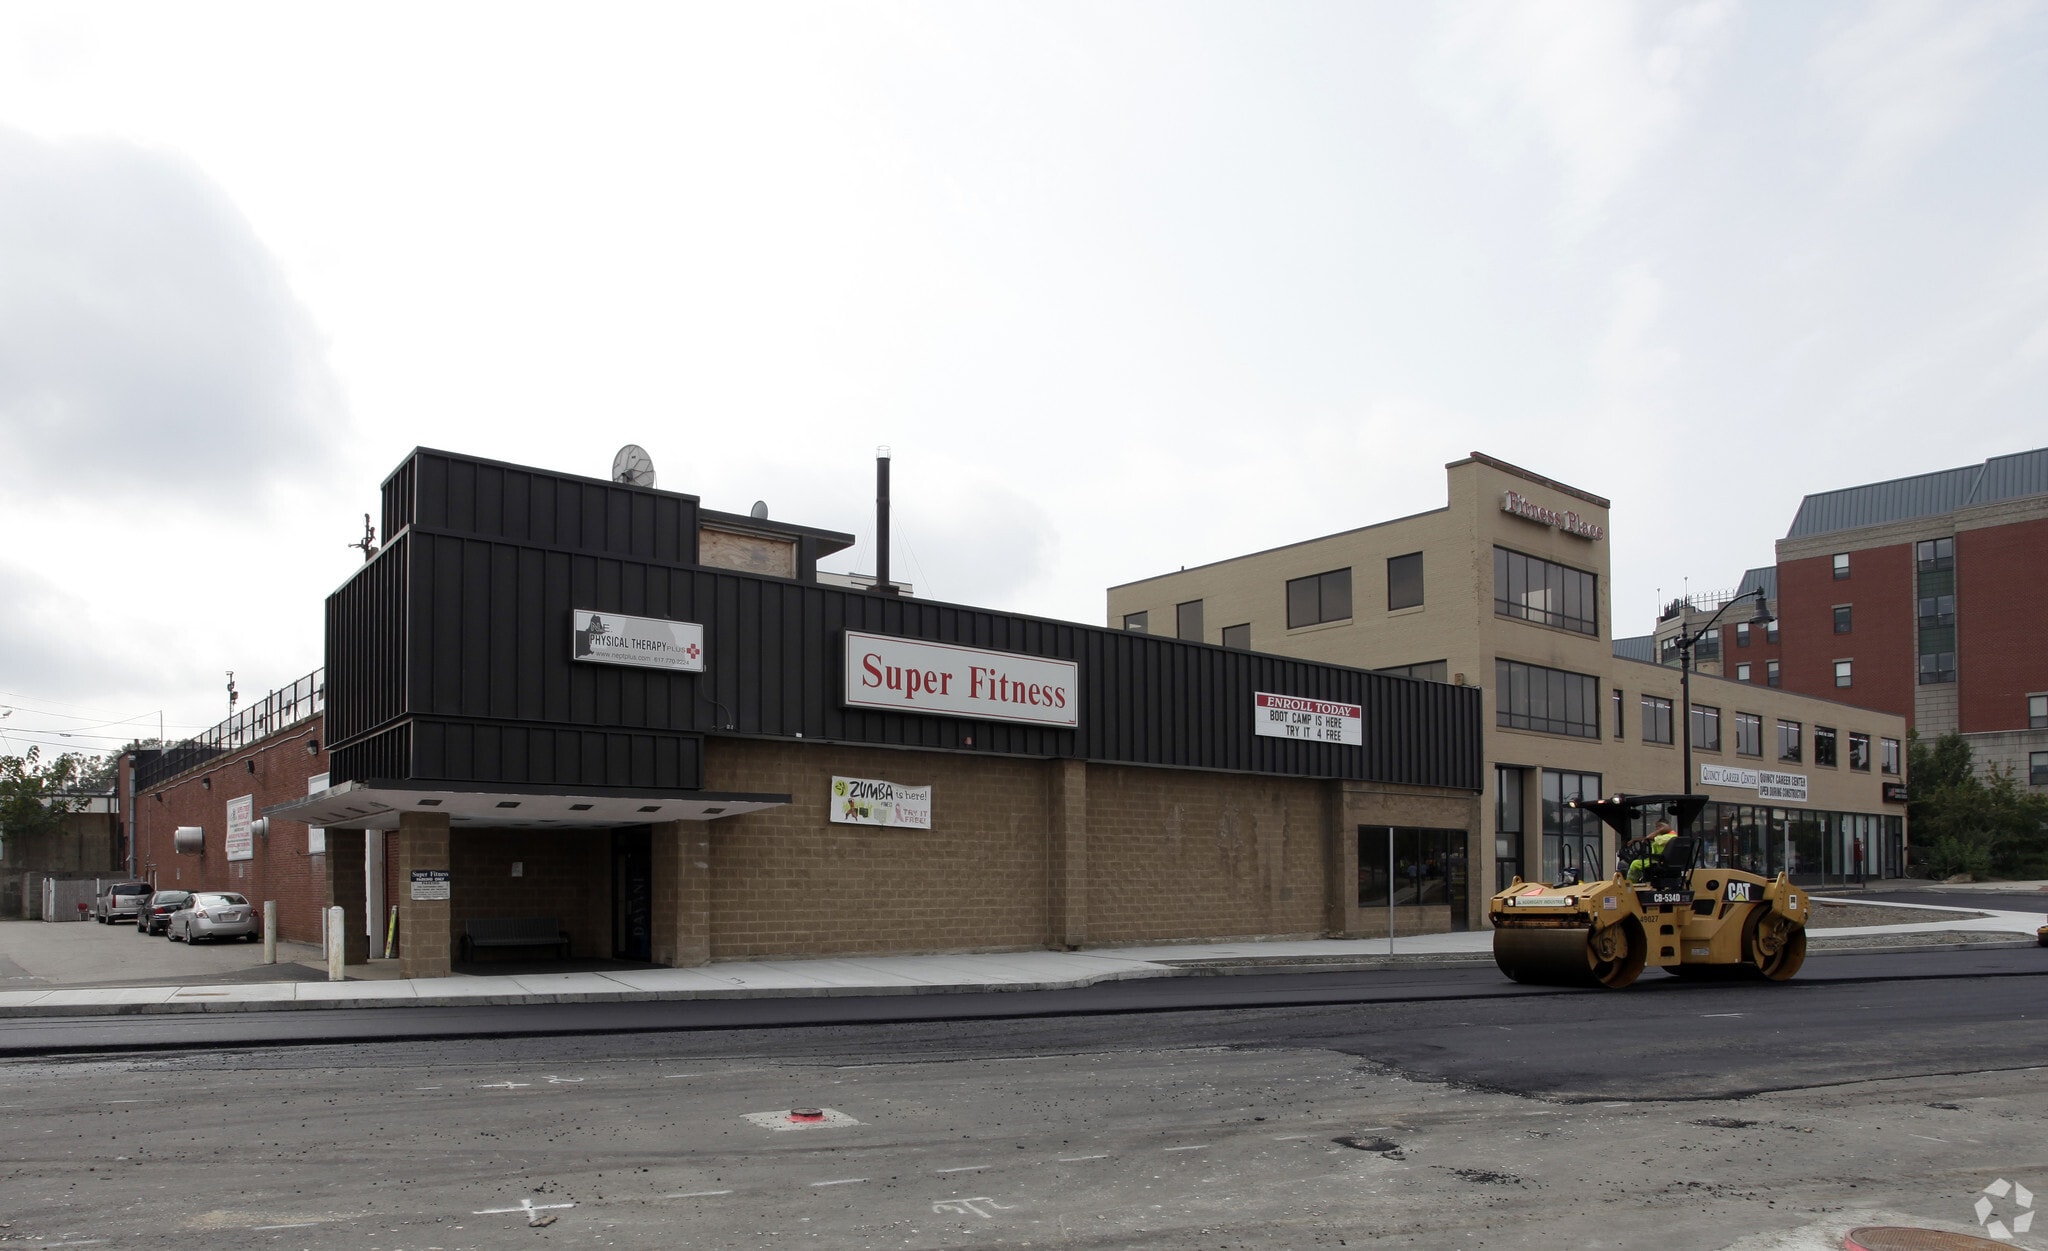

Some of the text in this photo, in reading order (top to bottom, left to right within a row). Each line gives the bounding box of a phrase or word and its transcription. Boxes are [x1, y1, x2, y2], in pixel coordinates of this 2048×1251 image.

[1504, 490, 1603, 541] Fitness Place
[590, 633, 629, 648] PHYSICAL
[632, 638, 667, 652] THERAPY
[862, 653, 1066, 708] Super Fitness
[1267, 696, 1352, 716] ENROLL TODAY
[1270, 710, 1342, 728] BOOT CAMP IS HERE
[1286, 725, 1341, 741] TRY IT 4 FREE
[1722, 769, 1740, 783] CAREER
[1741, 772, 1757, 785] CENTER
[849, 781, 927, 800] ZUMBA is here!
[412, 871, 428, 879] Super
[1654, 893, 1680, 903] CB-534D
[1728, 882, 1750, 901] CAT
